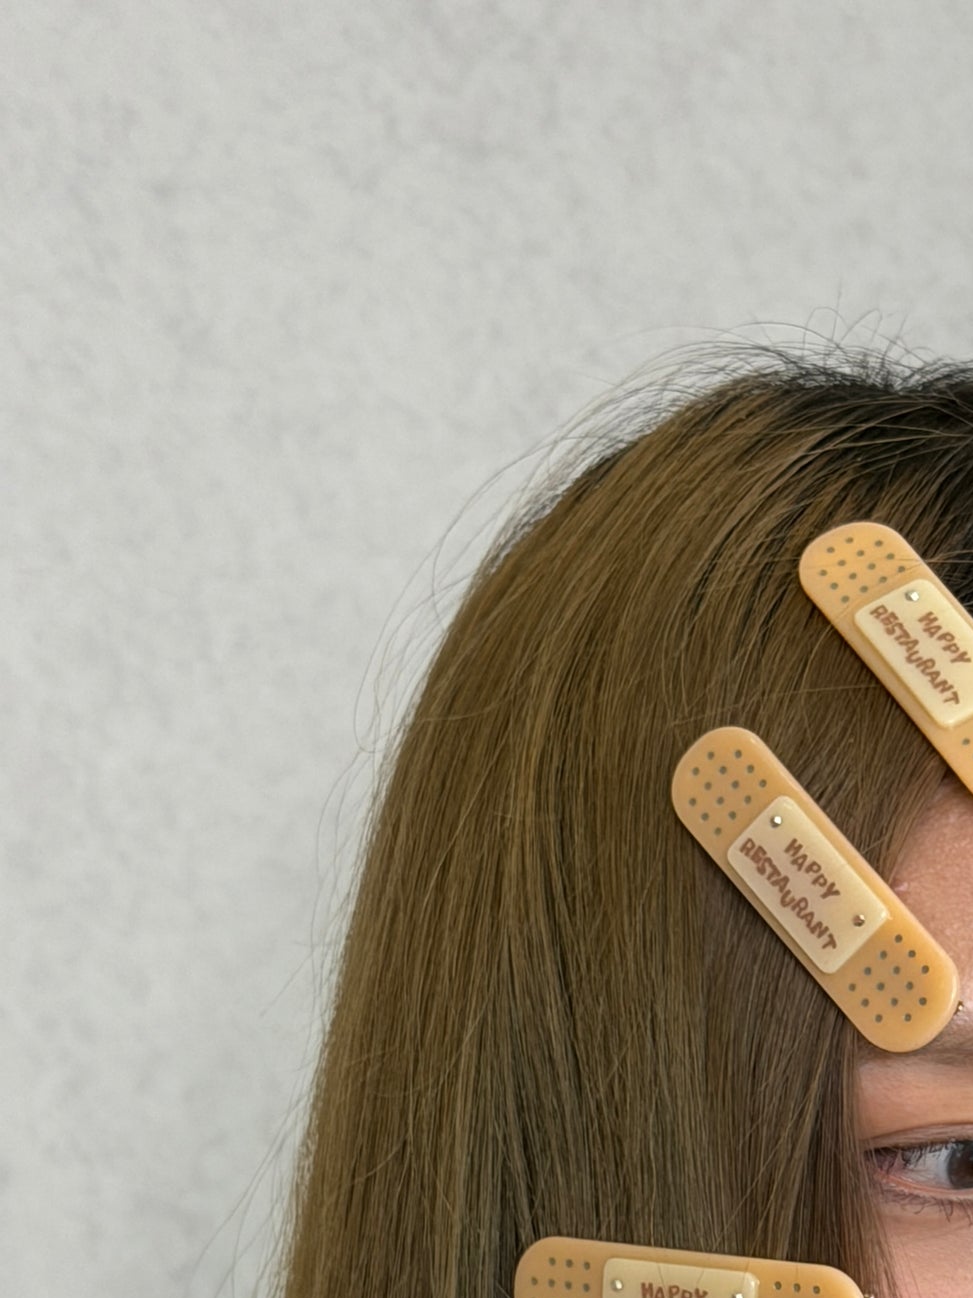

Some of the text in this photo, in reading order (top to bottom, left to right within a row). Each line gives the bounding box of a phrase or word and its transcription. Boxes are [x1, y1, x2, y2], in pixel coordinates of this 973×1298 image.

[870, 604, 960, 705] RESTAURANT
[918, 611, 971, 664] HAPPY
[739, 838, 837, 949] RESTAURANT
[784, 838, 841, 899] HAPPY
